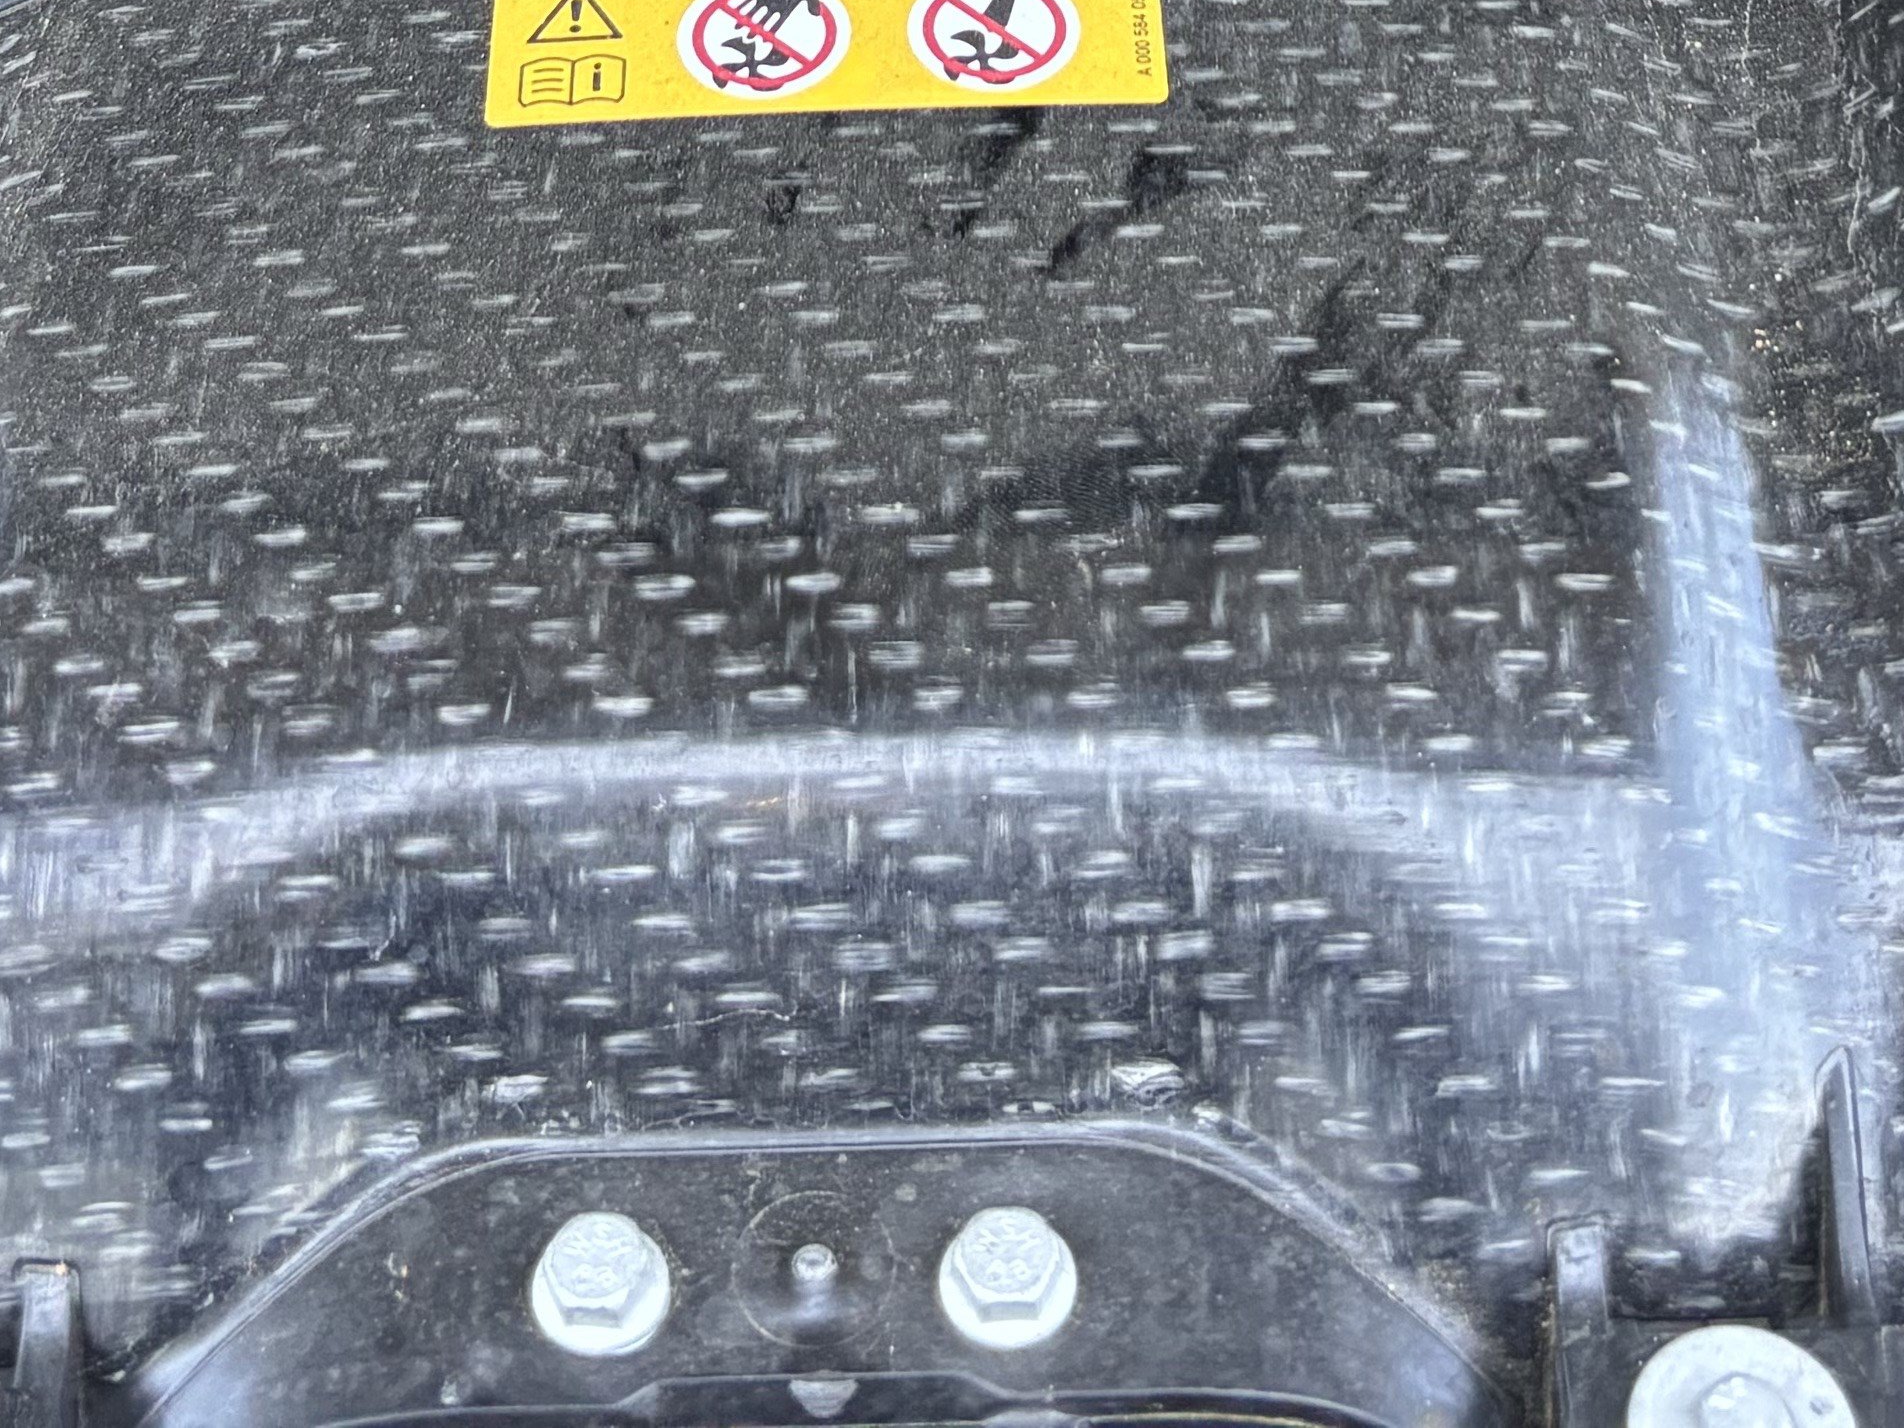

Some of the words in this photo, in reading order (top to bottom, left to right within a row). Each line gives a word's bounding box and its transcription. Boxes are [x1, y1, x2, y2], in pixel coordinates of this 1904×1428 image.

[1132, 13, 1149, 37] 584
[1134, 38, 1152, 64] 000
[1137, 66, 1152, 77] A
